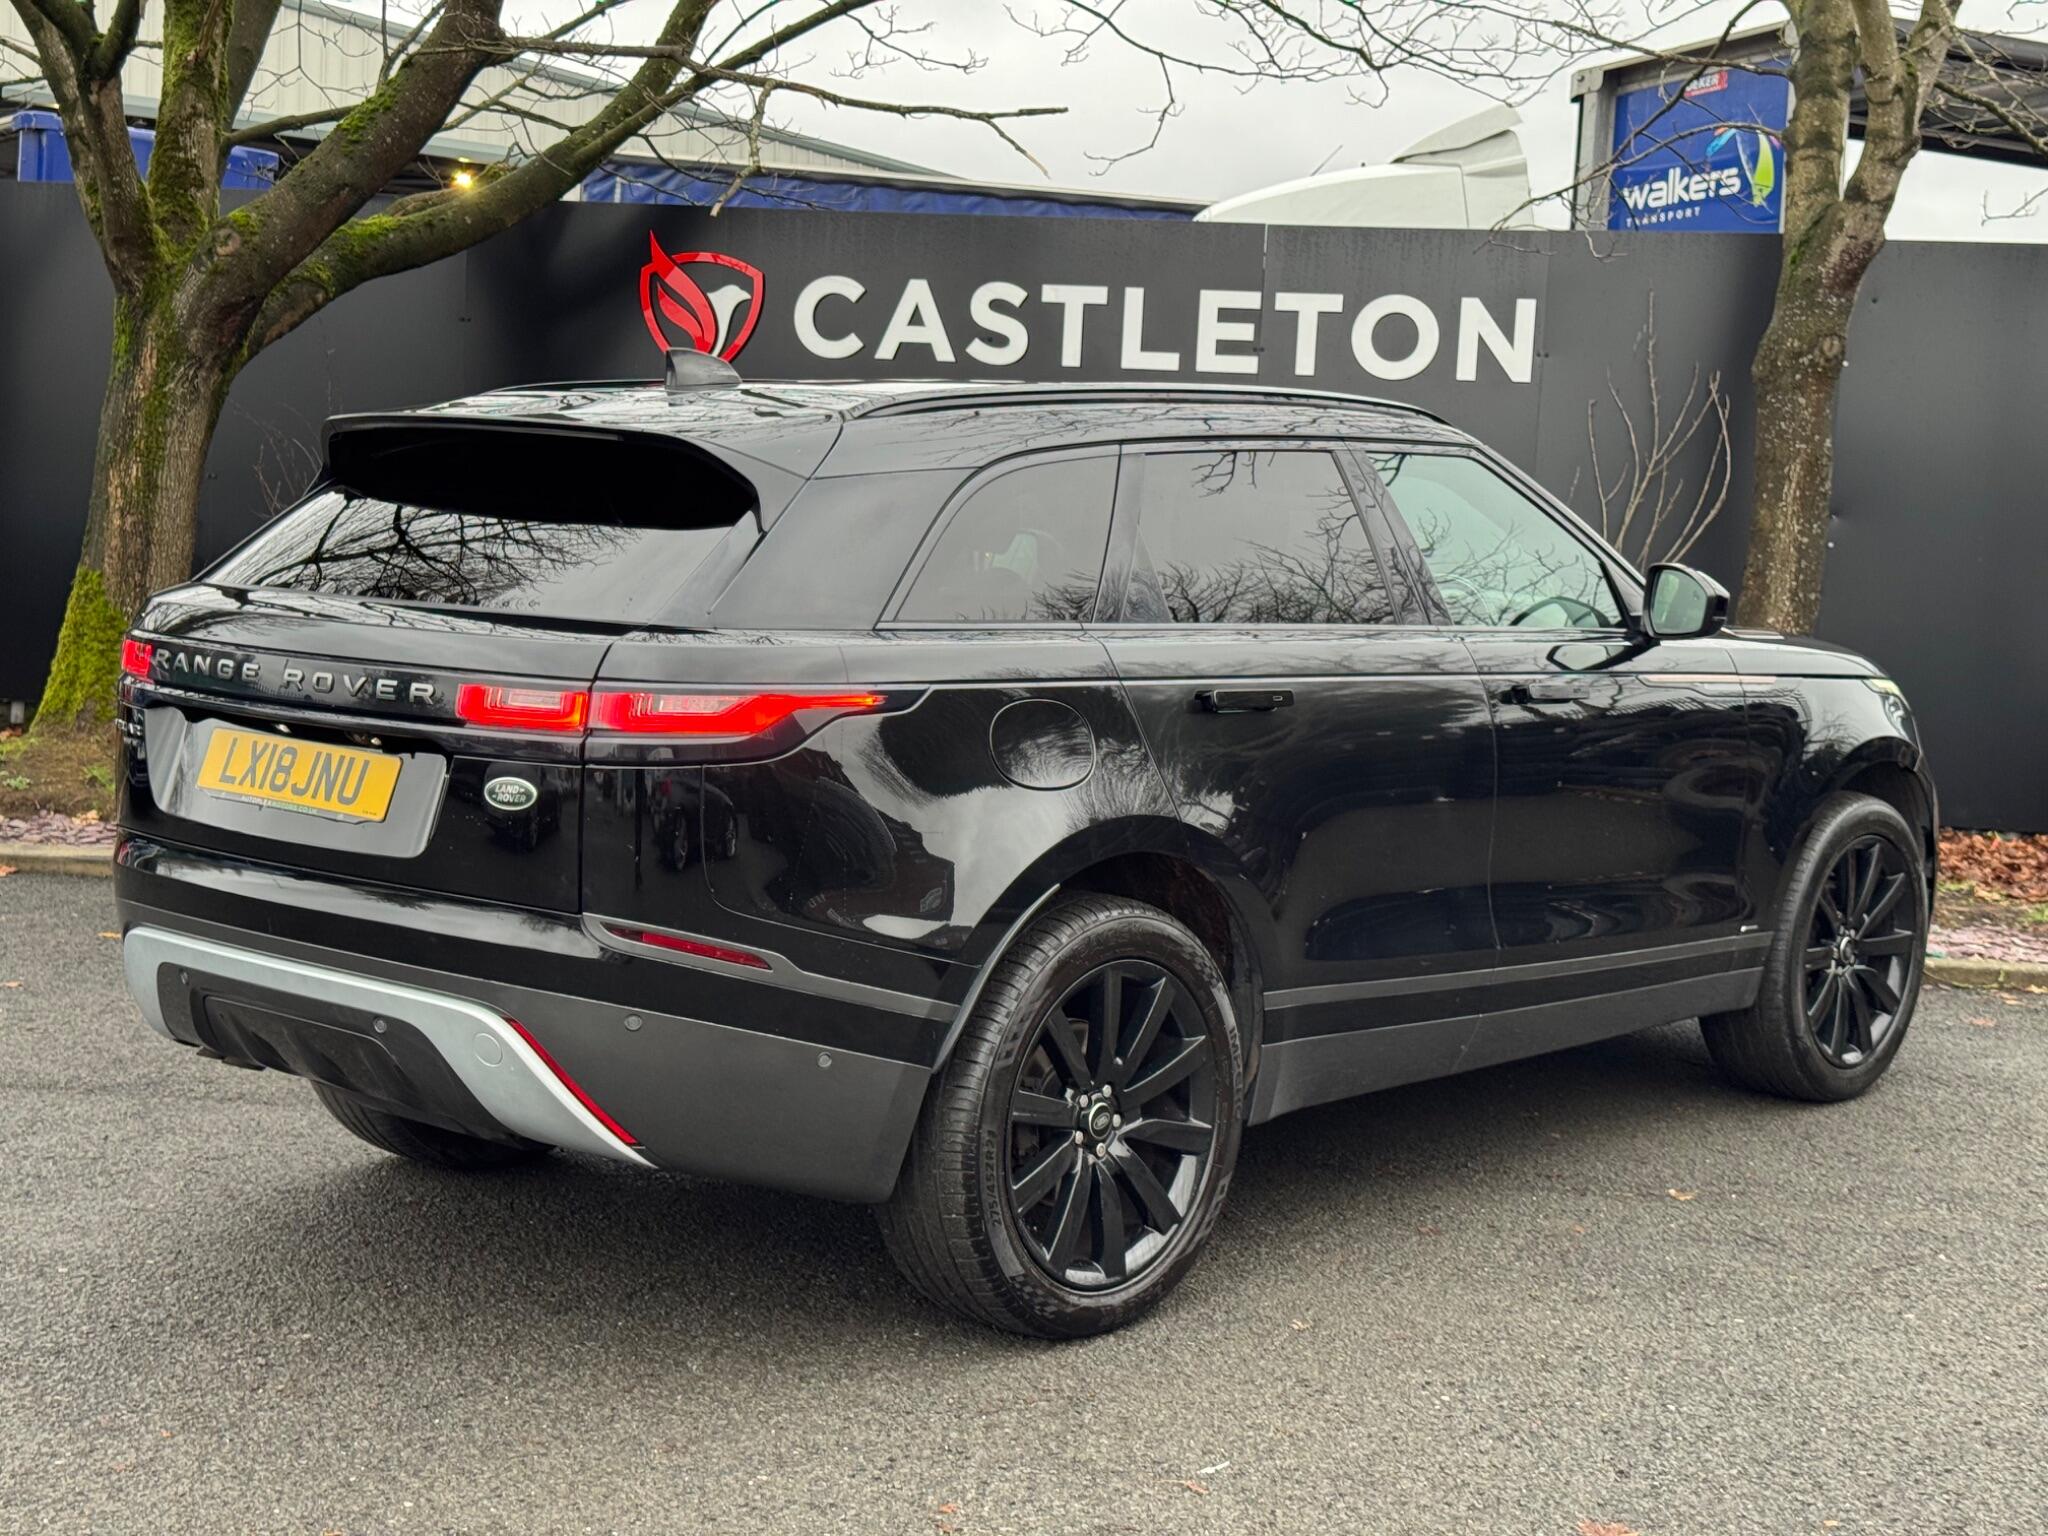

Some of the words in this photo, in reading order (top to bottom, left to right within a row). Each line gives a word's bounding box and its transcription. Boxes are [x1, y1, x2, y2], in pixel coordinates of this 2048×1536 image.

[1622, 167, 1742, 210] walkers
[794, 275, 1537, 383] CASTLETON
[155, 649, 261, 682] RANGE
[283, 667, 437, 705] ROVER
[495, 783, 520, 794] LAND
[496, 792, 526, 804] ROVER
